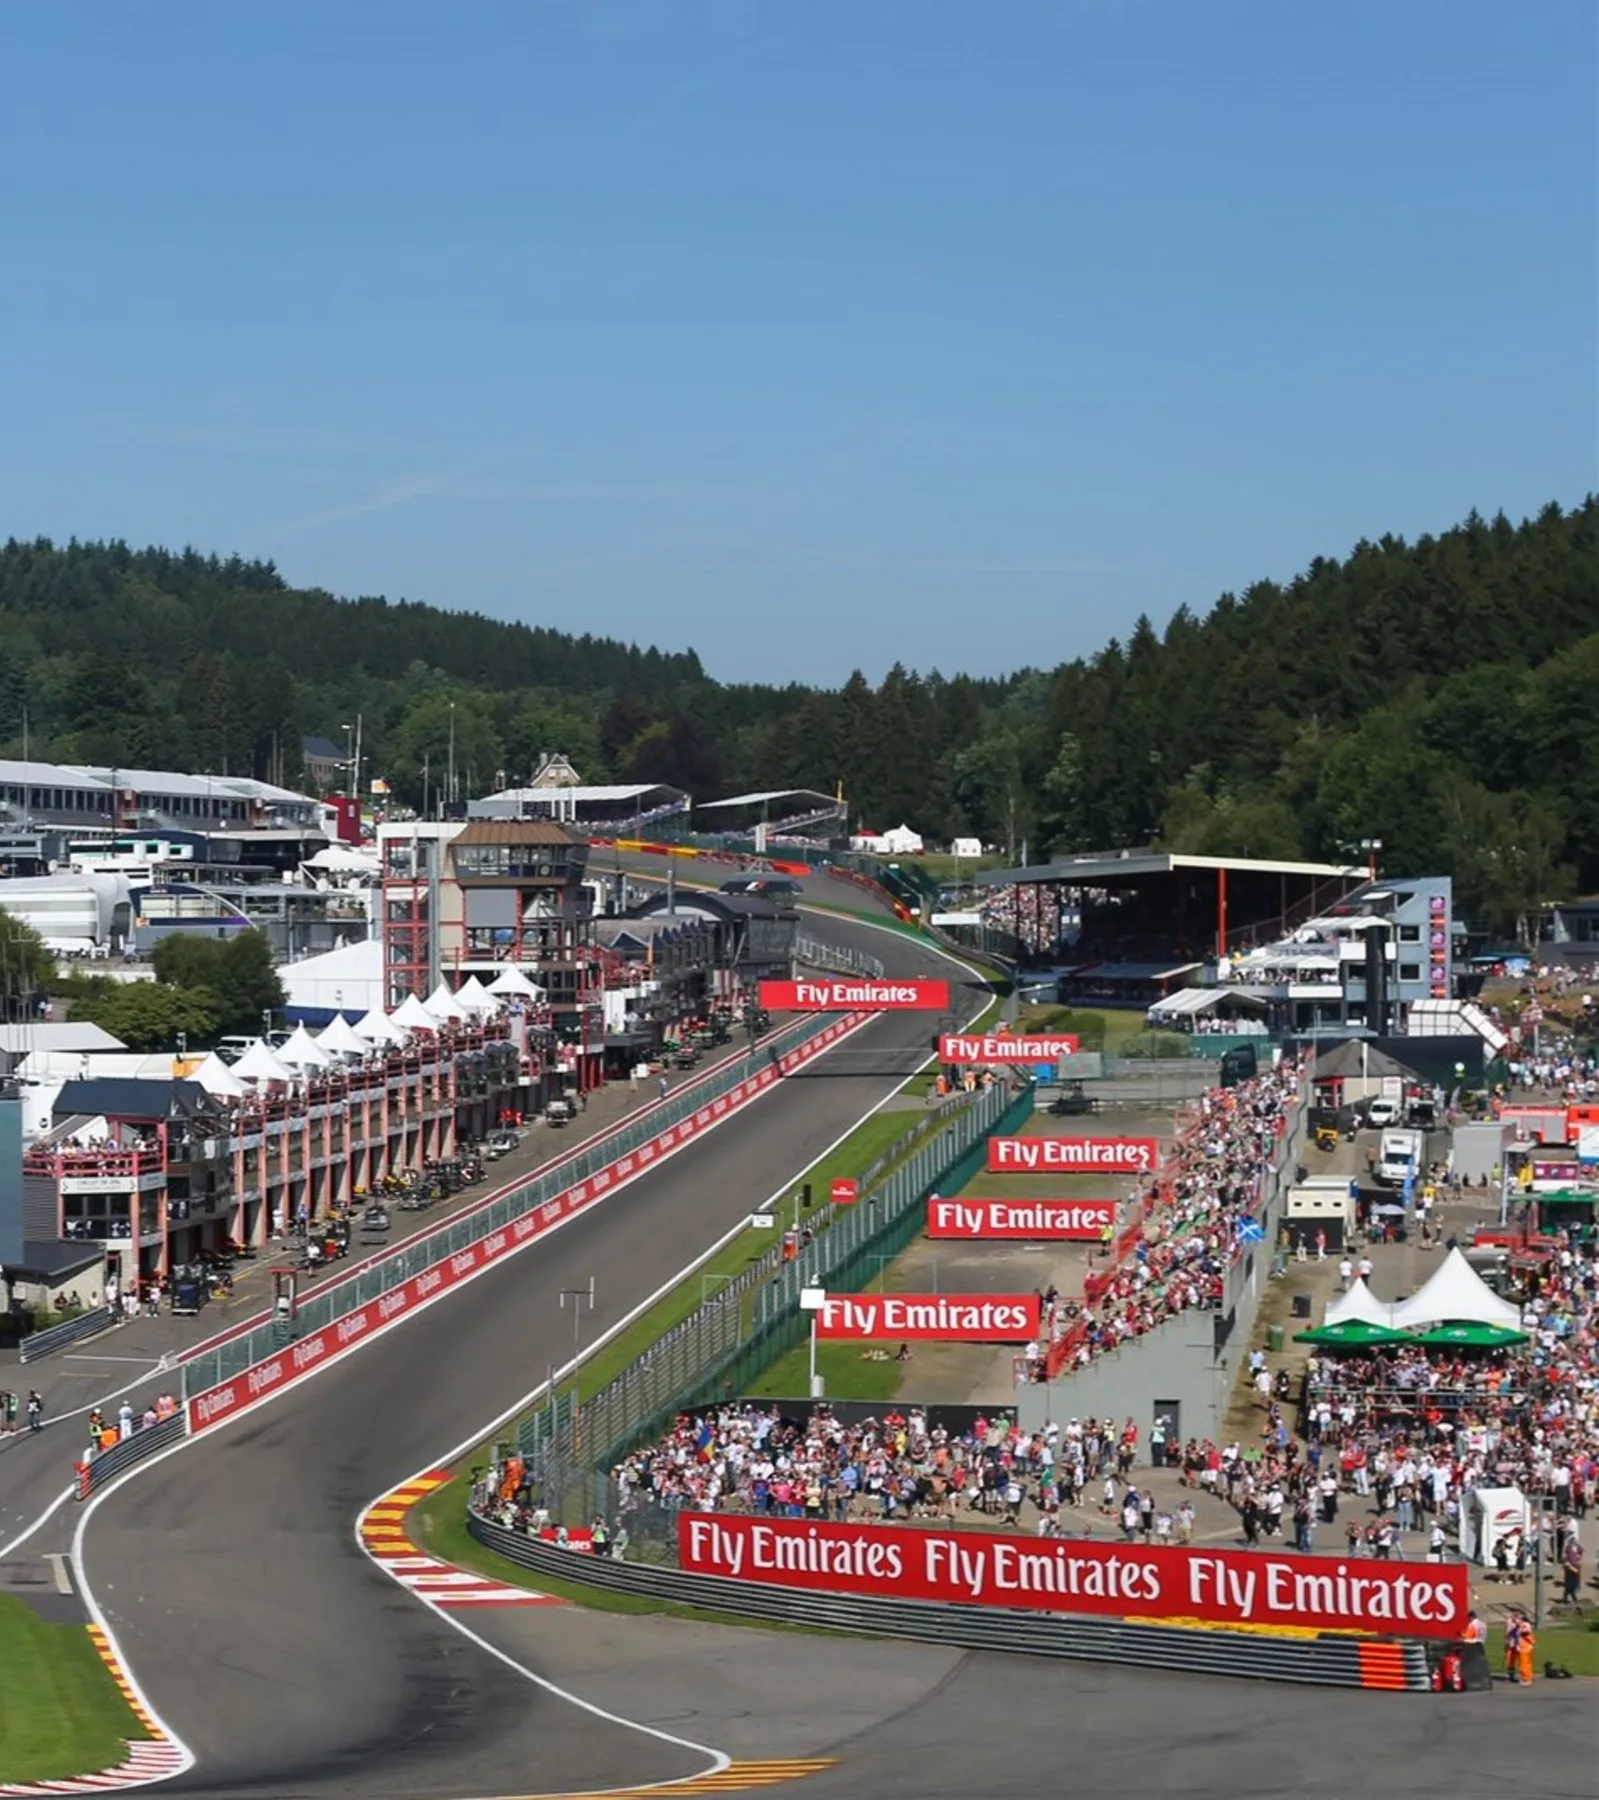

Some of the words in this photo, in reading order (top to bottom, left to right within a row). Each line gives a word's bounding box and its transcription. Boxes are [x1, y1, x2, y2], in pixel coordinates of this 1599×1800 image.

[796, 984, 829, 1006] Fly
[832, 983, 918, 1002] Emirates
[945, 1038, 980, 1060] Fly
[983, 1038, 1071, 1057] Emirates
[998, 1141, 1039, 1167] Fly
[1043, 1140, 1150, 1163] Emirates
[937, 1203, 984, 1233] Fly
[989, 1203, 1109, 1230] Emirates
[822, 1299, 877, 1334] Fly
[883, 1299, 1028, 1330] Emirates
[689, 1520, 744, 1575] Fly
[751, 1524, 903, 1579] Emirates
[924, 1538, 986, 1596] Fly
[992, 1543, 1161, 1600] Emirates
[1187, 1556, 1257, 1618] Fly
[1264, 1562, 1457, 1622] Emirates
